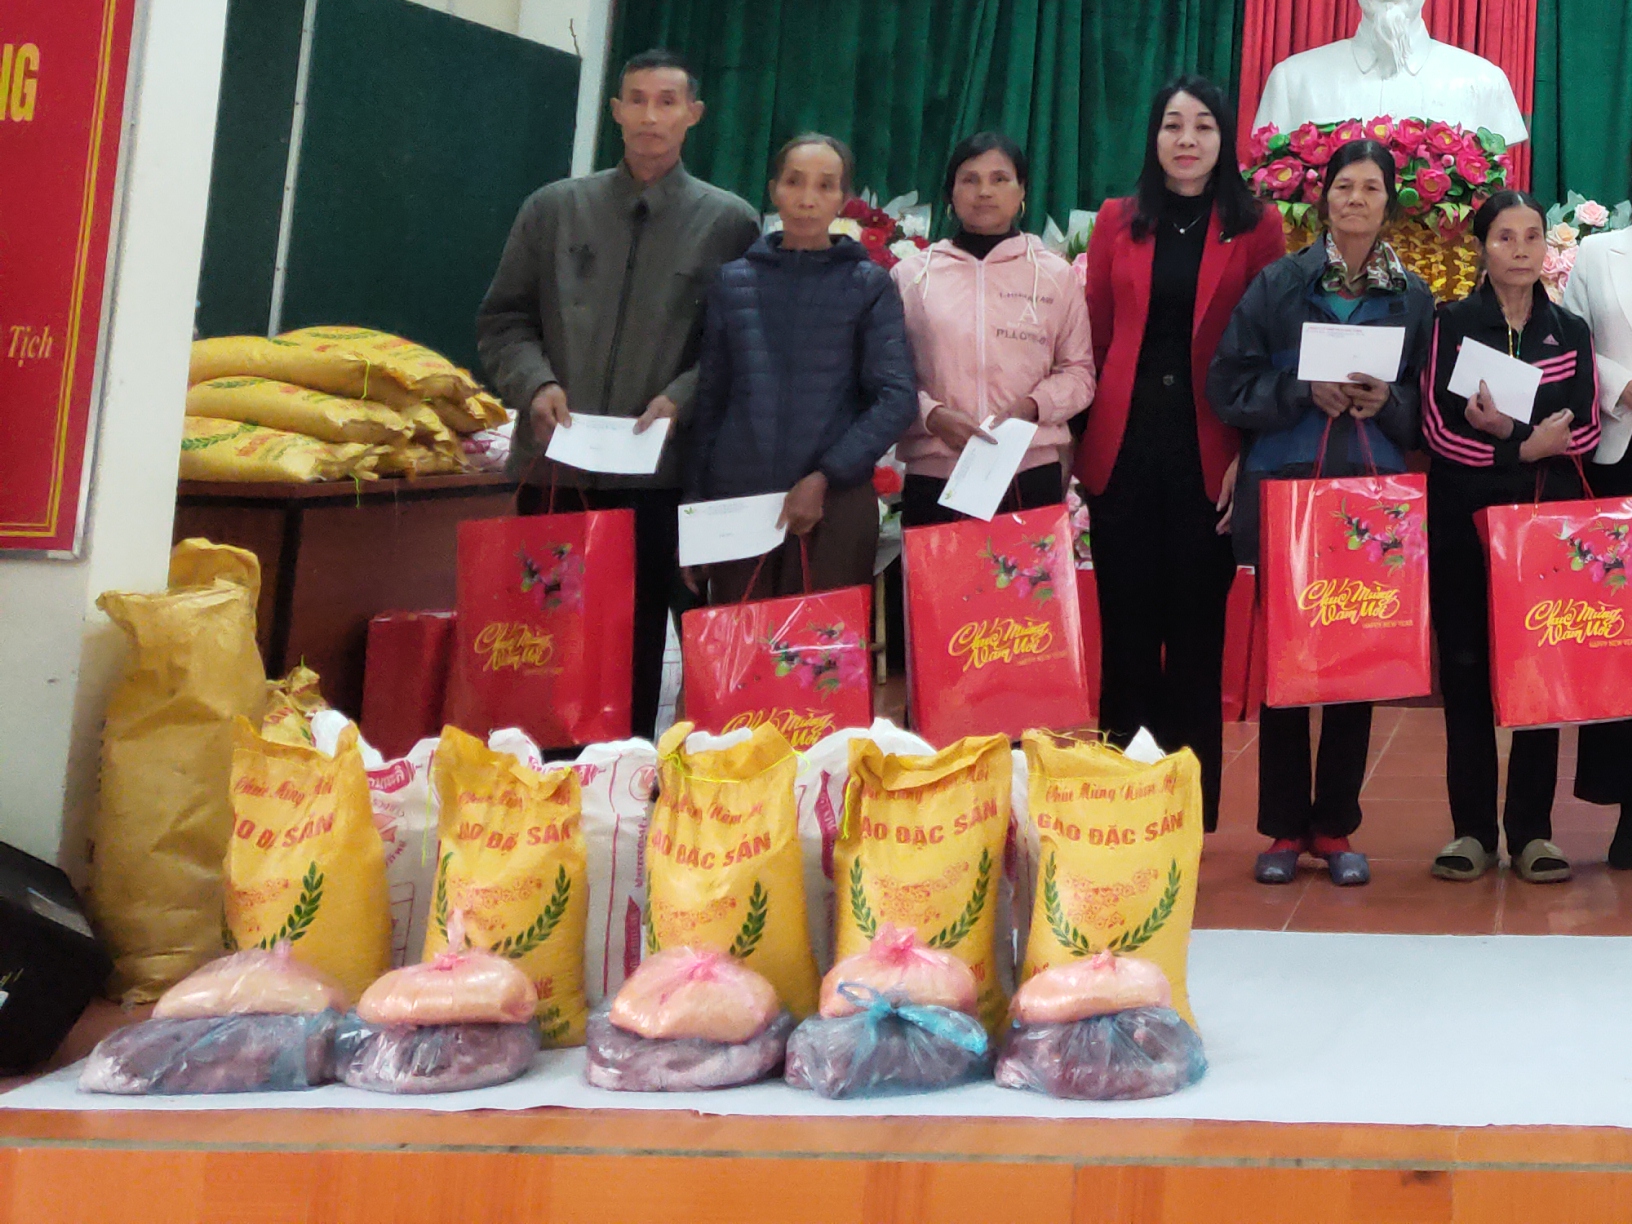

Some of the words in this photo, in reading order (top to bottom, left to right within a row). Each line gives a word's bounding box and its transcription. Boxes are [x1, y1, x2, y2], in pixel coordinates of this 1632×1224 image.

[8, 325, 53, 368] Tịch
[896, 825, 944, 850] ĐẶC
[954, 797, 997, 835] SẢN
[1089, 824, 1136, 850] ĐẶC
[1144, 809, 1184, 842] SẢN
